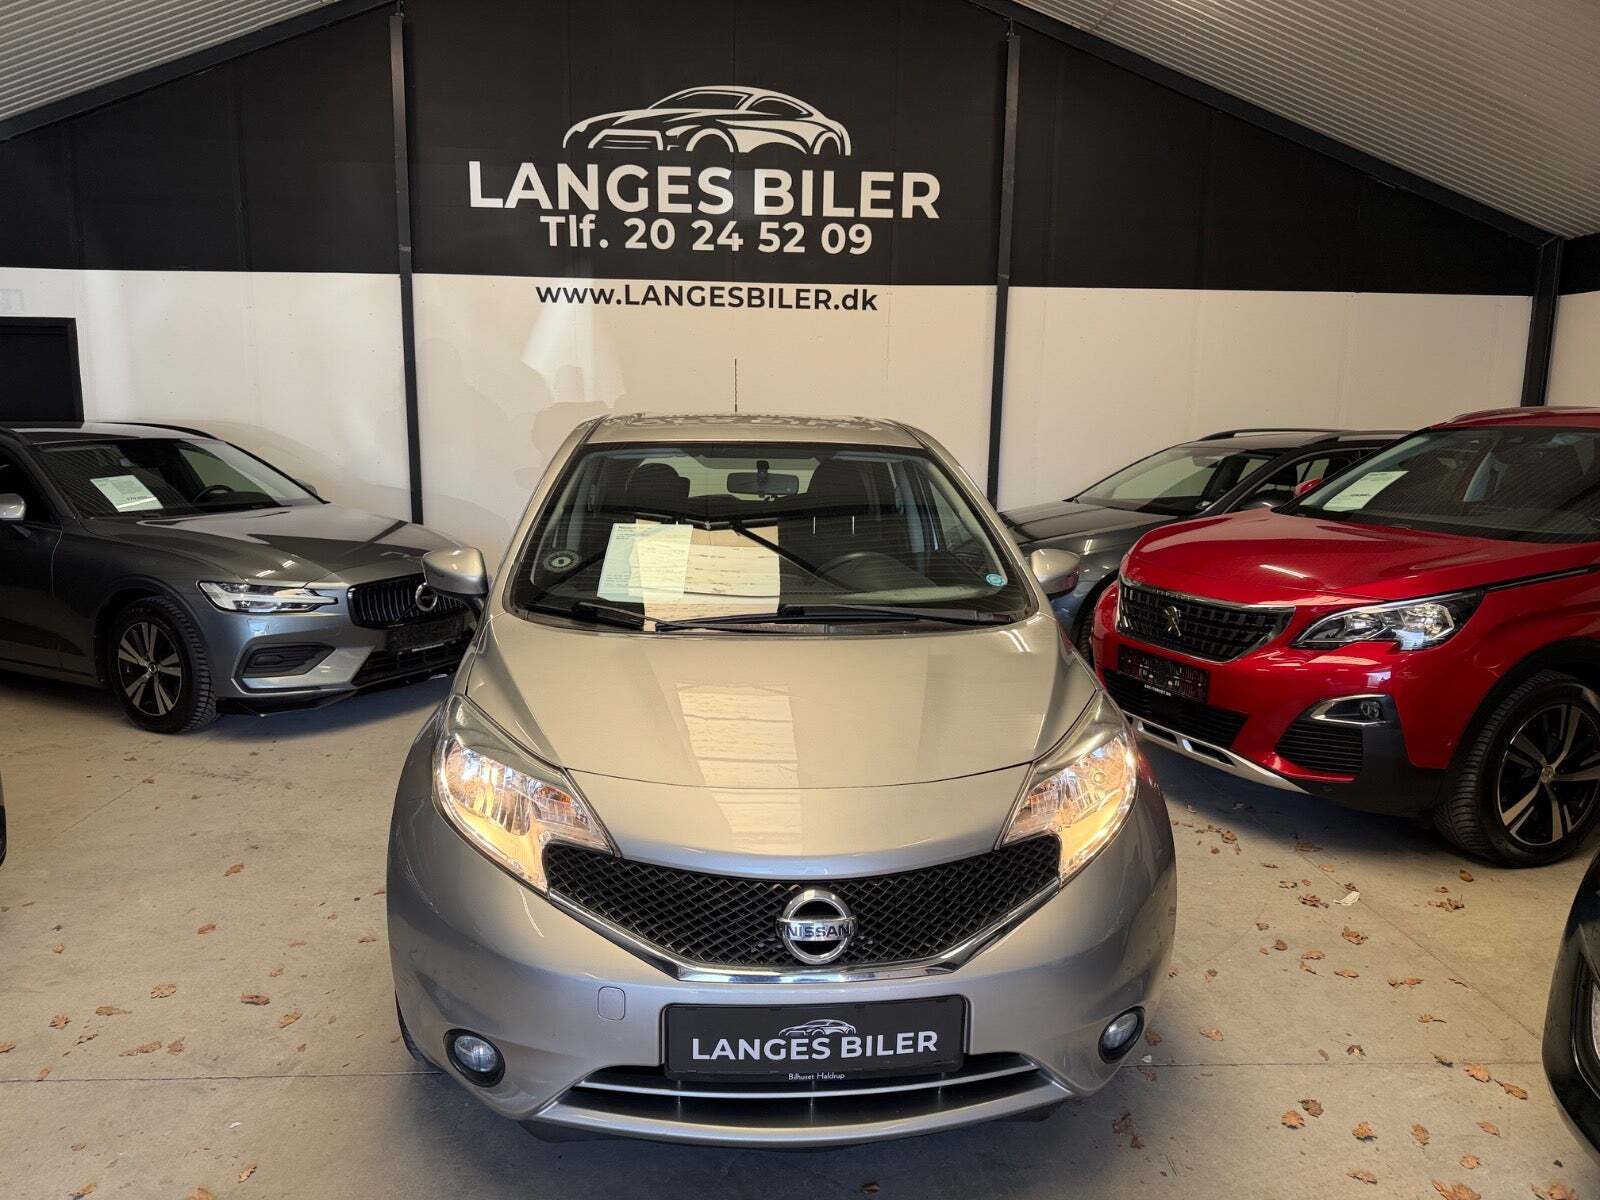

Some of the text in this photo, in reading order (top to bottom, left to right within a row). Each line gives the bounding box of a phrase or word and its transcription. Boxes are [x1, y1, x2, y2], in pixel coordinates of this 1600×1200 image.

[468, 160, 941, 219] LANGES BILER
[539, 214, 873, 255] Tlf. 20 24 52 09
[535, 283, 878, 311] www.LANGESBILER.dk
[786, 925, 851, 938] NISSAN
[692, 1030, 938, 1061] LANGES BILER
